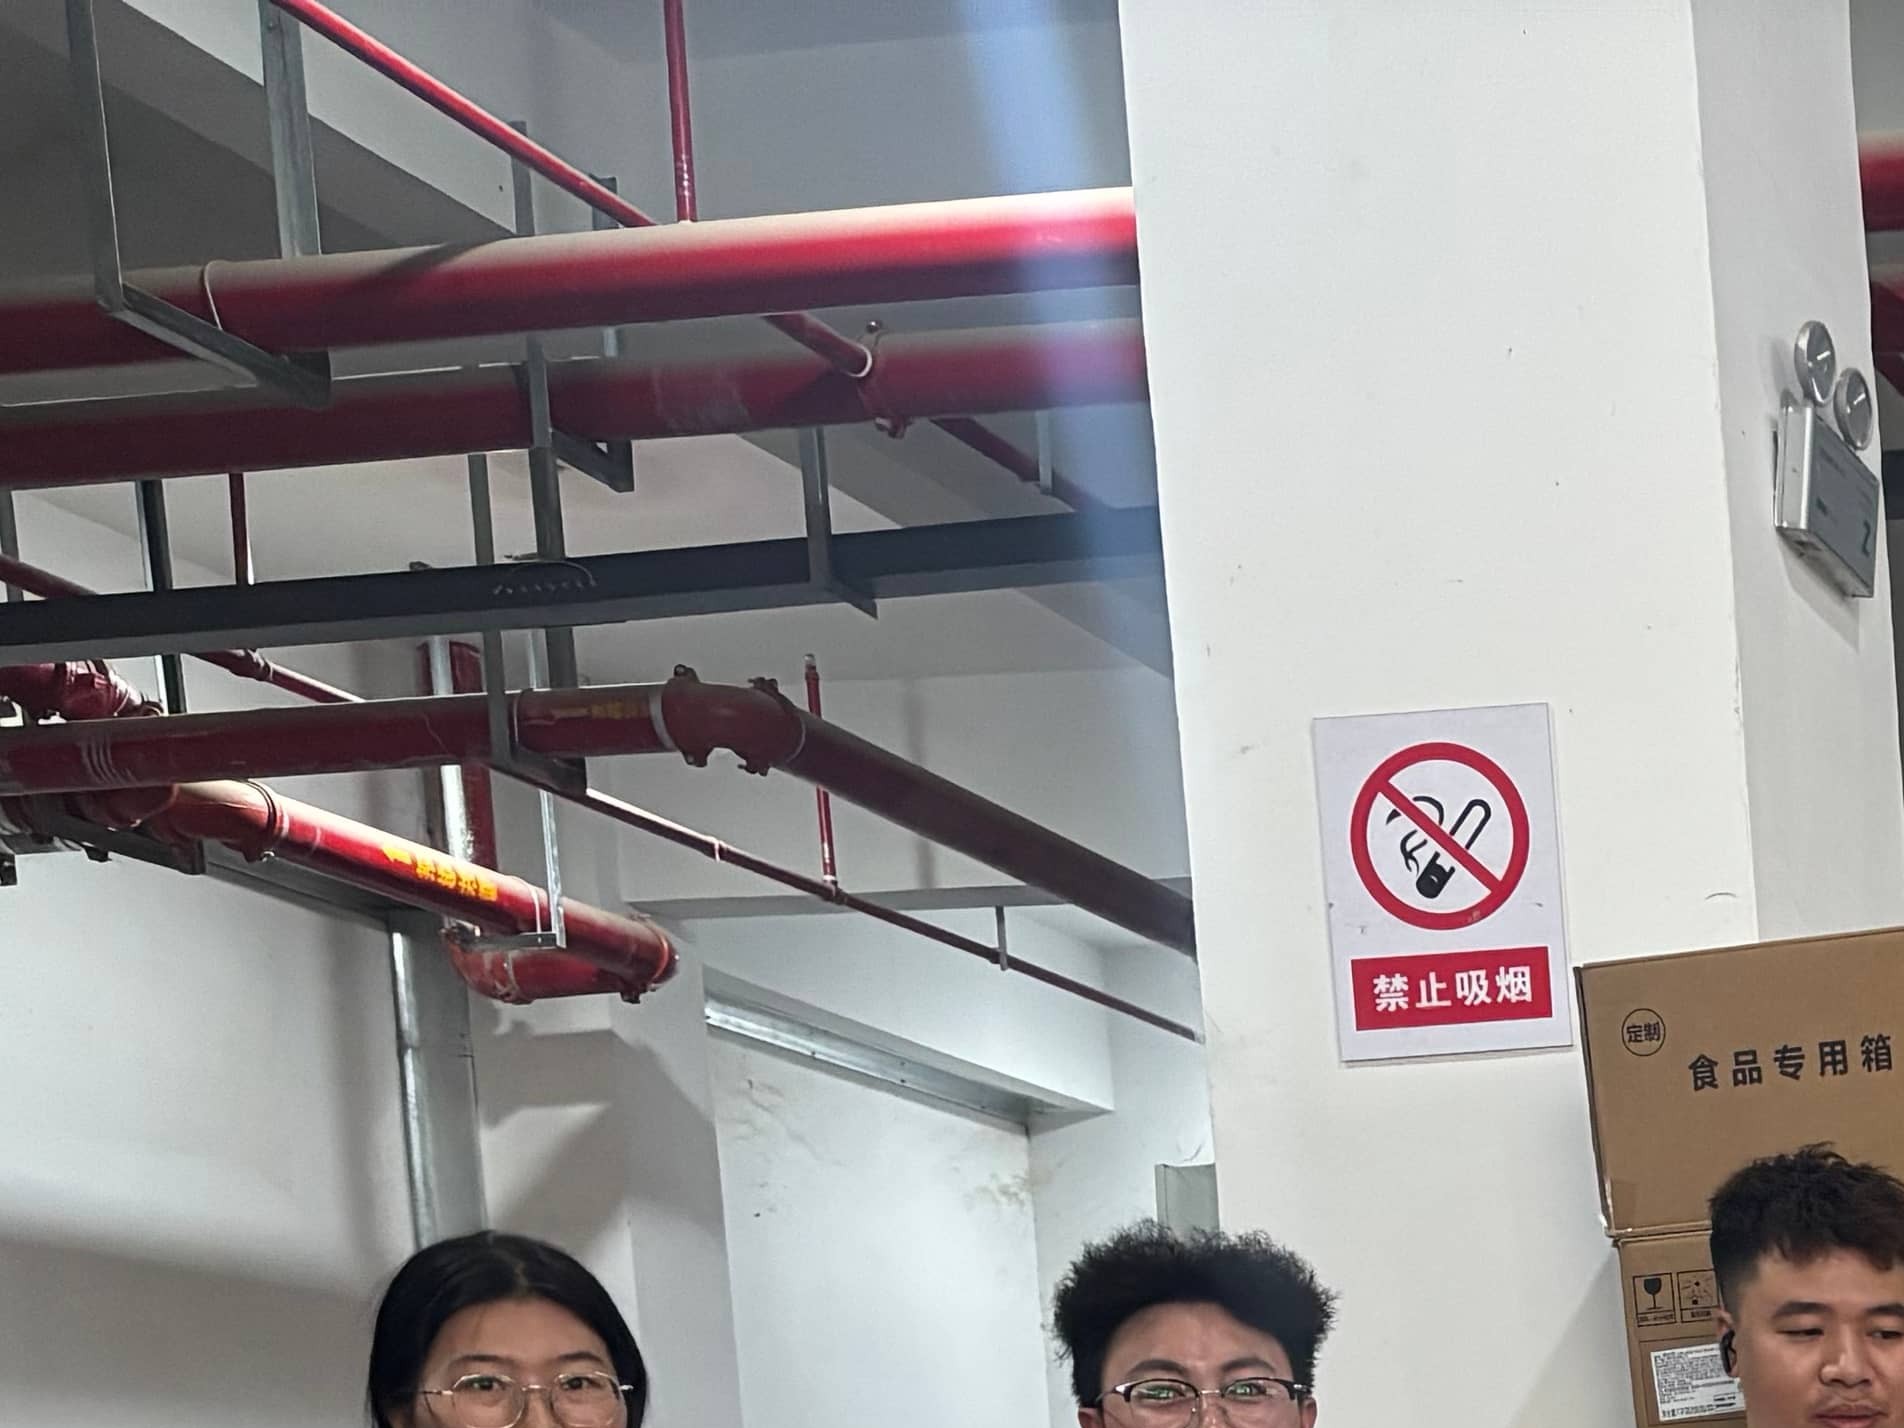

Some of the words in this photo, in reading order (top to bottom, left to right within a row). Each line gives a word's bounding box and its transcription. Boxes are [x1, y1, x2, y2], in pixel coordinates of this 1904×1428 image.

[1373, 966, 1533, 1012] 禁止吸烟
[1626, 1022, 1662, 1044] 定制
[1688, 1034, 1894, 1092] 食品专用箱
